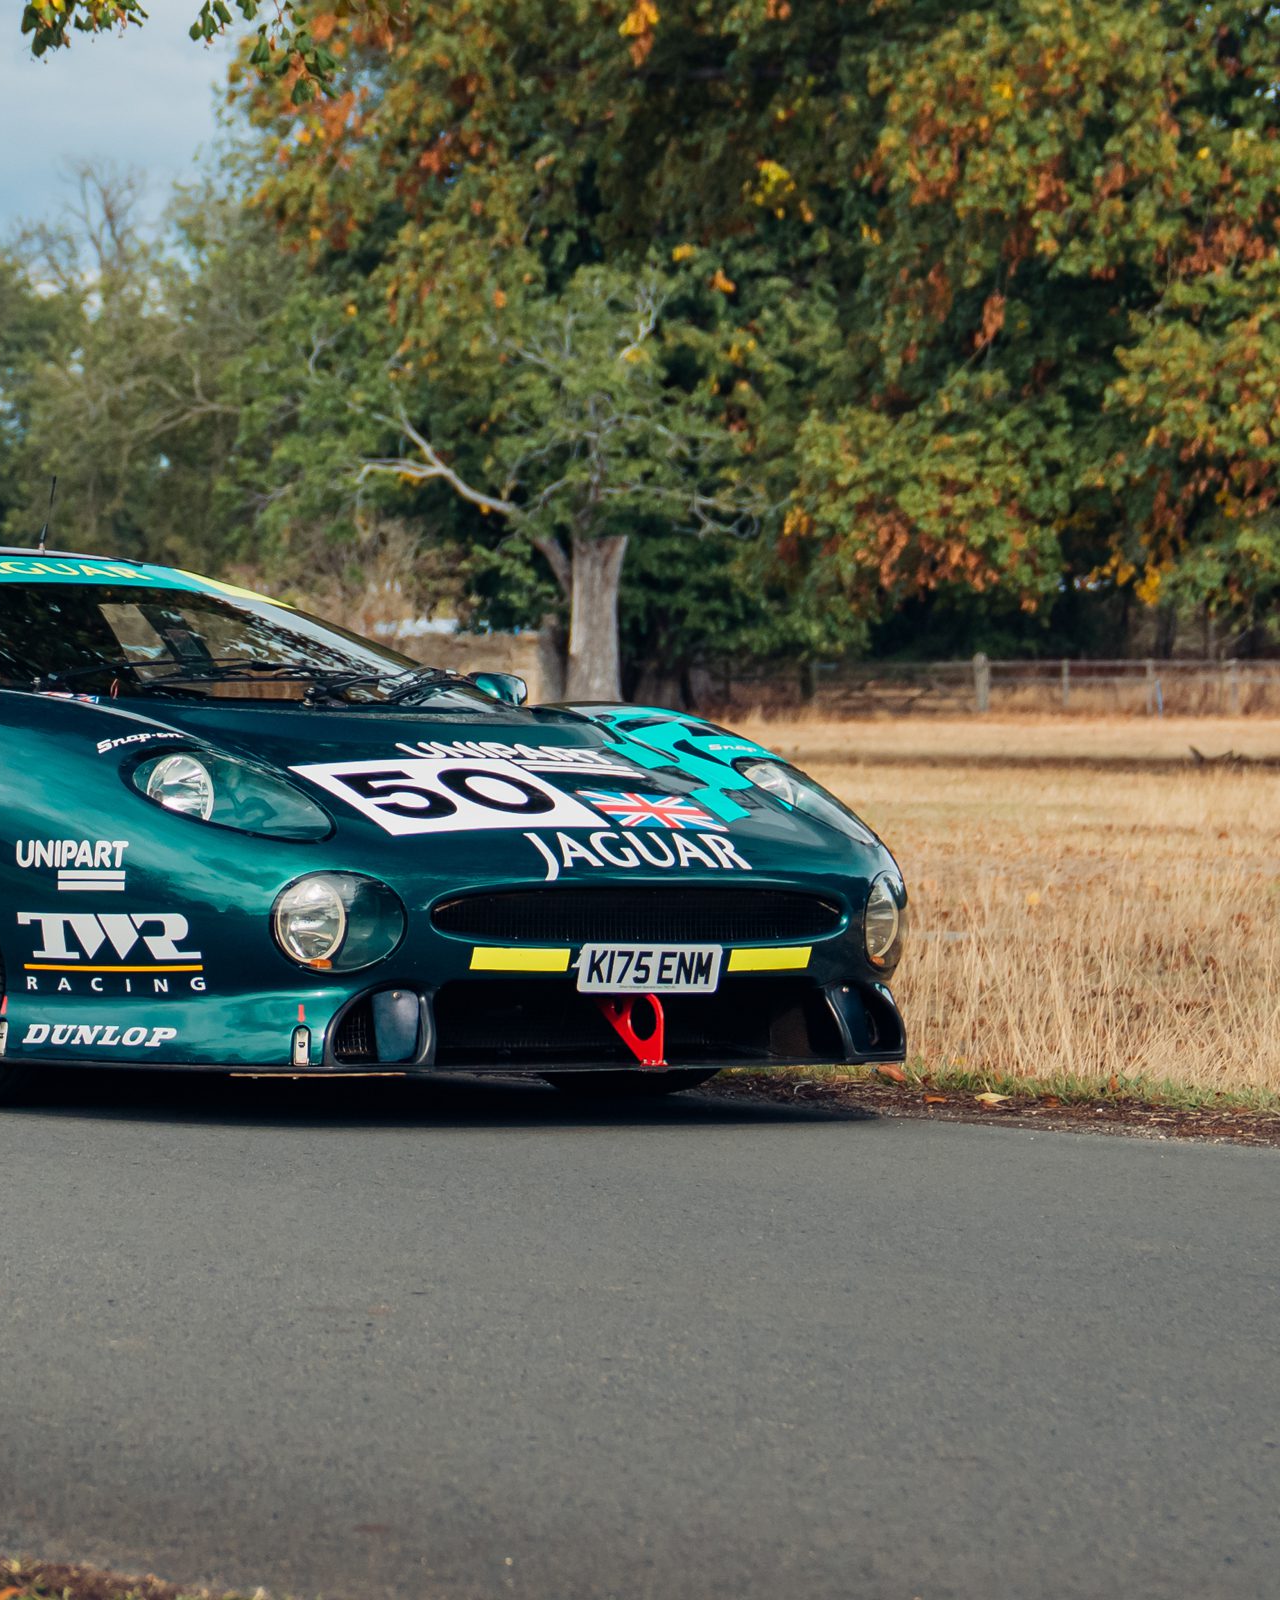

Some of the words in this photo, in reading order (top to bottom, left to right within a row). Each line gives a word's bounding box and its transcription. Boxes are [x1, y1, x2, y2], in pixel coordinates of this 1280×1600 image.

[96, 732, 184, 754] Snap-on
[395, 740, 613, 766] UNIPART
[331, 767, 556, 820] 50
[15, 839, 130, 869] UNIPART
[522, 831, 753, 882] JAGUAR
[16, 911, 203, 961] TWR
[586, 949, 654, 984] K175
[656, 950, 714, 985] ENM
[26, 976, 207, 992] RACING
[22, 1023, 178, 1048] DUNLOP
